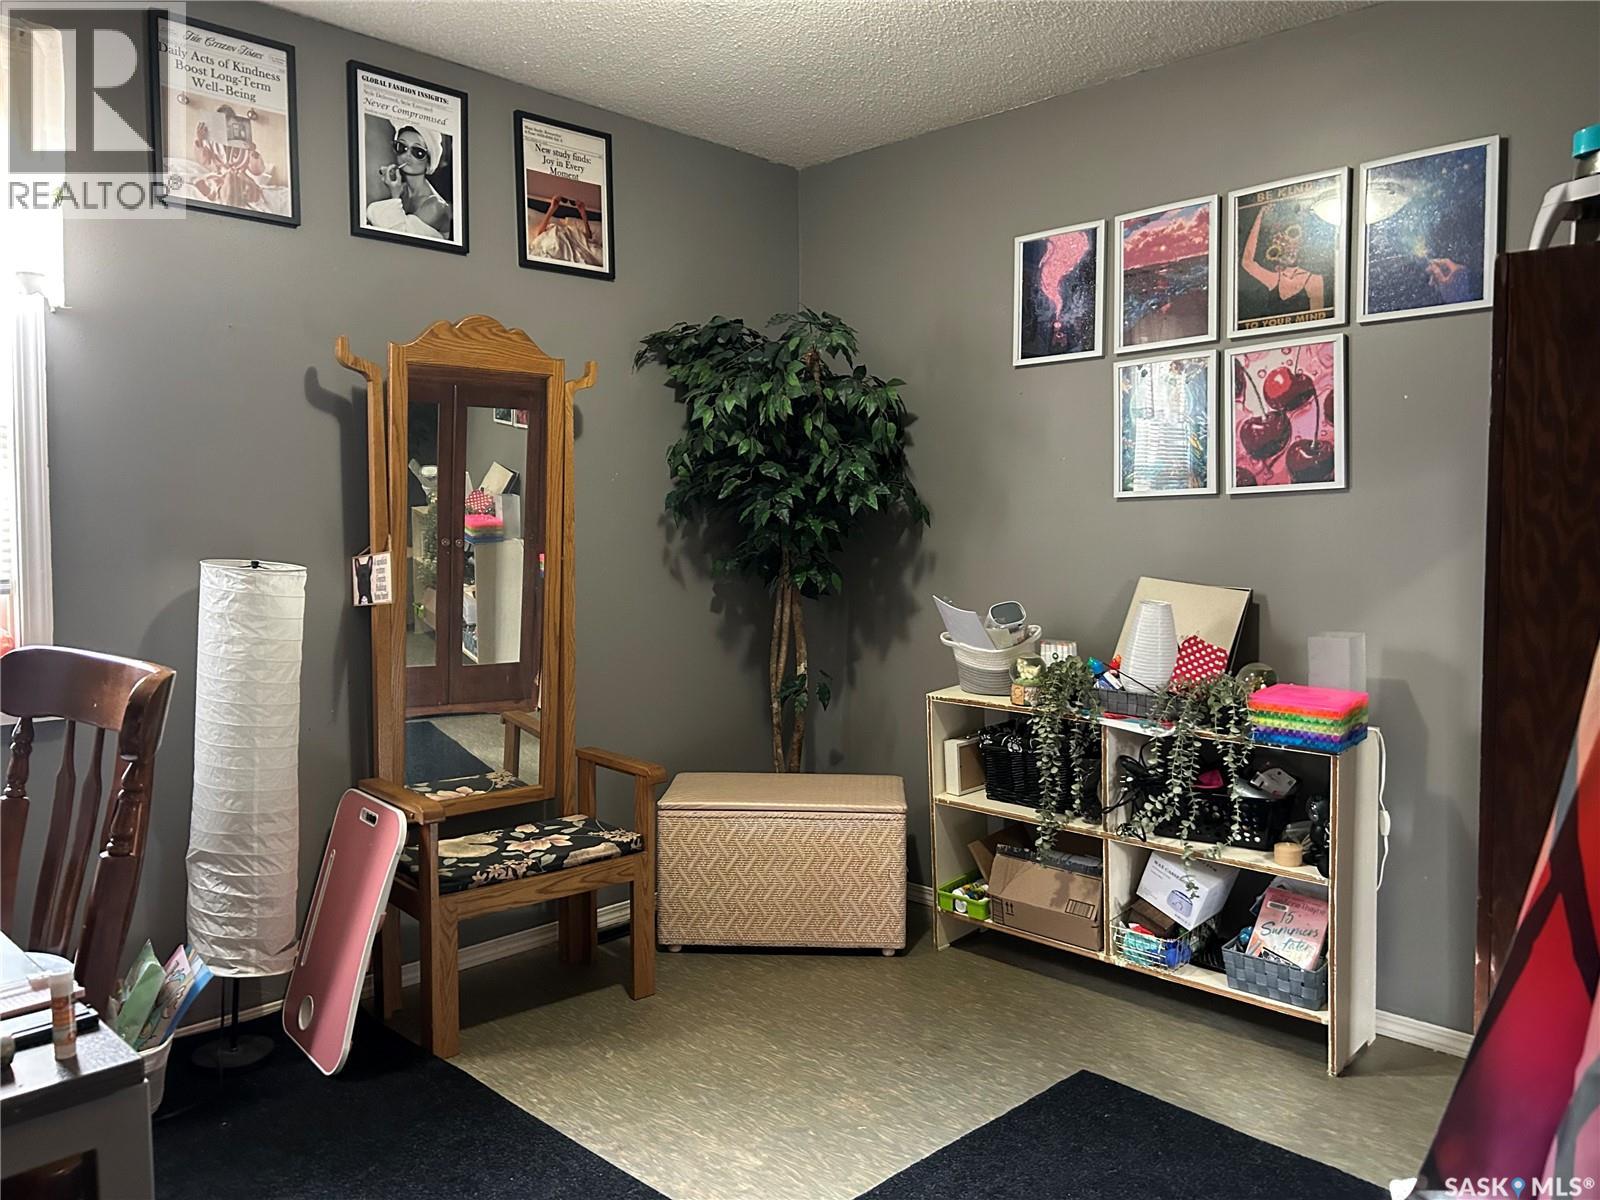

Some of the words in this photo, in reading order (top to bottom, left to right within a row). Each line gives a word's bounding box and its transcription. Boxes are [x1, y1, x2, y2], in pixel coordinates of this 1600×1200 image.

[159, 41, 188, 59] Daily
[191, 51, 215, 66] Acts
[218, 59, 230, 69] of
[233, 61, 281, 82] Kindness
[175, 59, 207, 76] Boost
[211, 68, 271, 93] Long-Term
[191, 76, 256, 103] Well-Being
[361, 75, 388, 88] GLOBAL
[388, 82, 416, 96] FASHION
[417, 90, 449, 105] INSIGHTS:
[363, 97, 390, 110] Never
[392, 105, 448, 126] Compromised
[535, 143, 551, 154] New
[553, 147, 570, 161] study
[572, 152, 592, 165] finds:
[542, 155, 555, 167] Joy
[556, 158, 564, 167] in
[565, 161, 585, 173] Every
[550, 167, 579, 180] Moment
[1256, 191, 1273, 202] BE
[1278, 182, 1313, 198] KIND
[1244, 321, 1259, 330] TO
[1262, 316, 1292, 327] YOUR
[1295, 311, 1327, 323] MIND
[1280, 911, 1296, 924] 15
[1261, 921, 1319, 938] Summers
